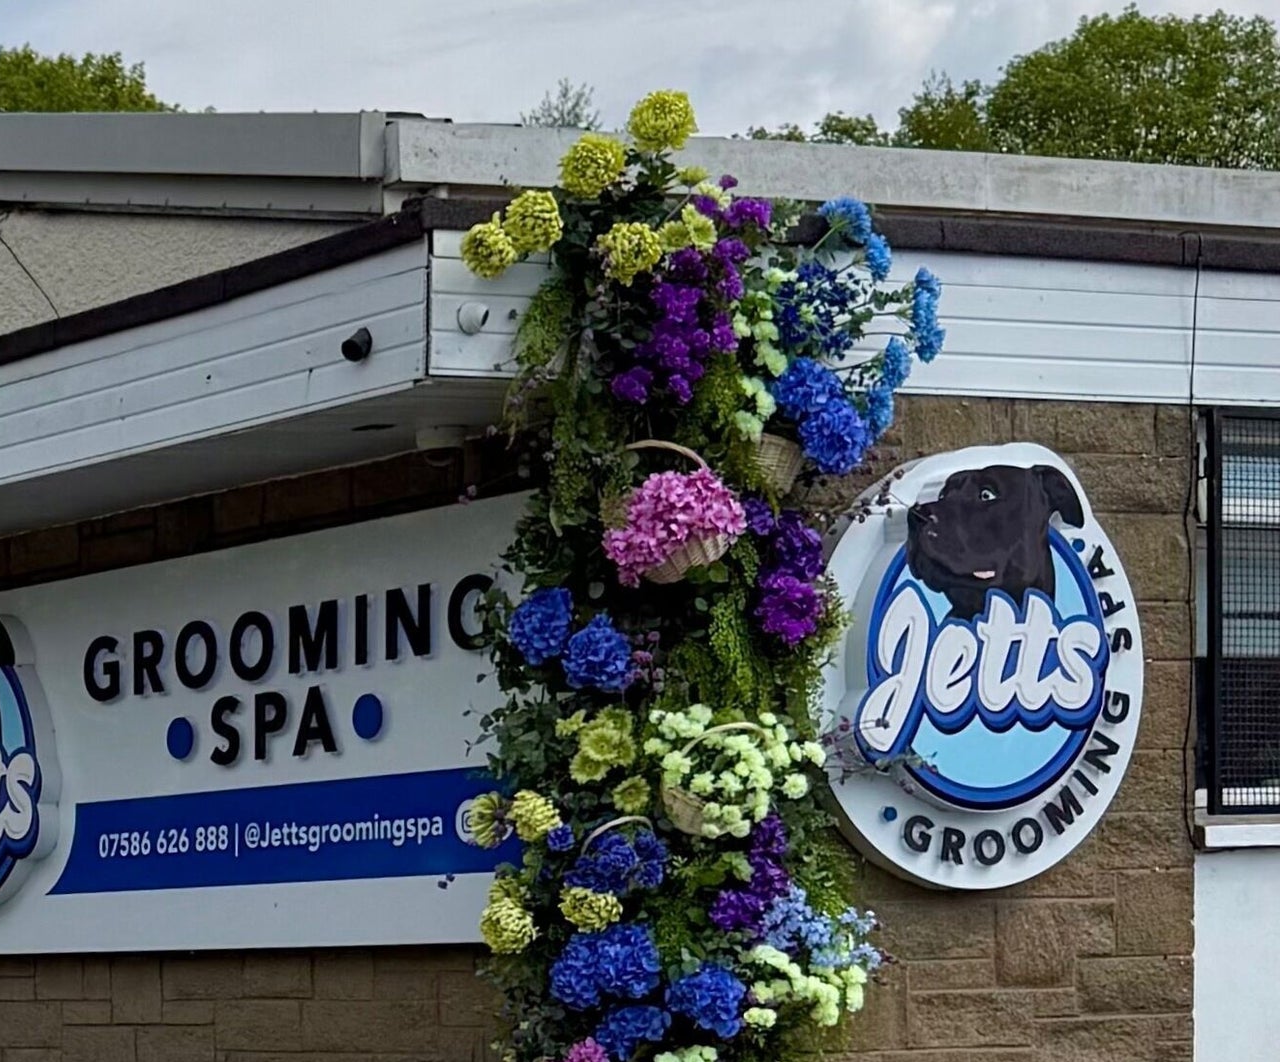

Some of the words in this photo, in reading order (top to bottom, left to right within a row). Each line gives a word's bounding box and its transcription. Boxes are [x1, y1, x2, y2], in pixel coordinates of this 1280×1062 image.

[83, 573, 497, 702] GROOMING
[859, 585, 1102, 753] Jetts
[210, 686, 338, 766] SPA
[902, 690, 1130, 866] GROOMING
[1086, 544, 1132, 655] SPA
[98, 830, 151, 857] 07586
[156, 828, 189, 854] 626
[195, 825, 228, 852] 888
[244, 813, 443, 852] @Jettsgroomingspa
